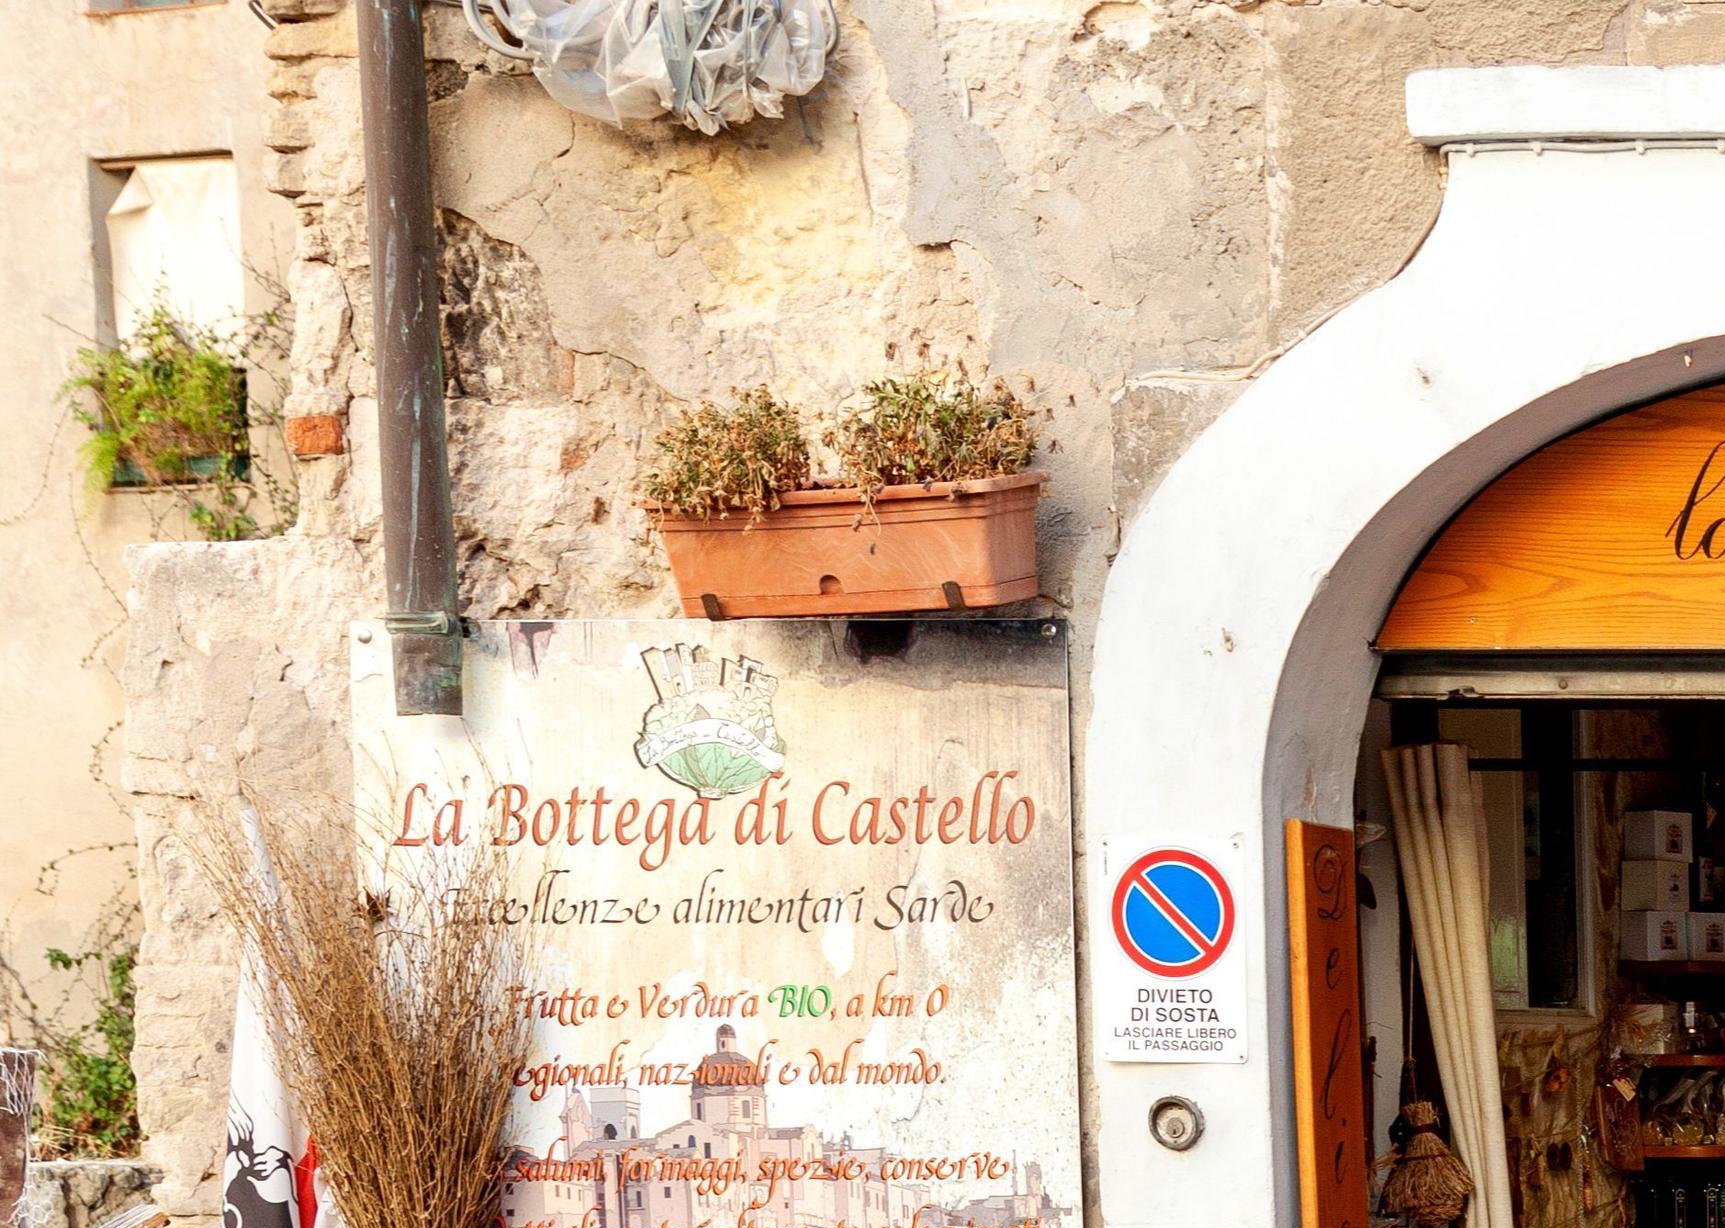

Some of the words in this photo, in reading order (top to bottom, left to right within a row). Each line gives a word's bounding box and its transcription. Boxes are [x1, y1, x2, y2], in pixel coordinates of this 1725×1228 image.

[392, 782, 469, 846] La
[487, 783, 717, 872] Bottega
[735, 770, 793, 845] di
[812, 770, 1036, 845] Castello
[673, 868, 865, 933] alimentari
[874, 880, 994, 930] Sarde
[506, 983, 599, 1026] Frutta
[607, 995, 629, 1018] e
[638, 982, 760, 1018] Verdura
[768, 984, 837, 1020] BIO,
[846, 994, 864, 1018] a
[872, 970, 914, 1018] km
[1131, 1007, 1149, 1022] DI
[1155, 1007, 1220, 1023] SOSTA
[1137, 988, 1213, 1004] DIVIETO
[1114, 1027, 1183, 1039] LASCIARE
[1187, 1027, 1237, 1039] LIBERO
[1128, 1040, 1140, 1050] IL
[1144, 1040, 1224, 1052] PASSAGGIO
[513, 1040, 628, 1101] egionali,
[639, 1039, 771, 1085] nazionali
[779, 1062, 801, 1085] e
[806, 1039, 864, 1085] dal
[857, 1047, 947, 1085] mondo.
[751, 1150, 872, 1209] spezie,
[880, 1151, 1011, 1180] conserve
